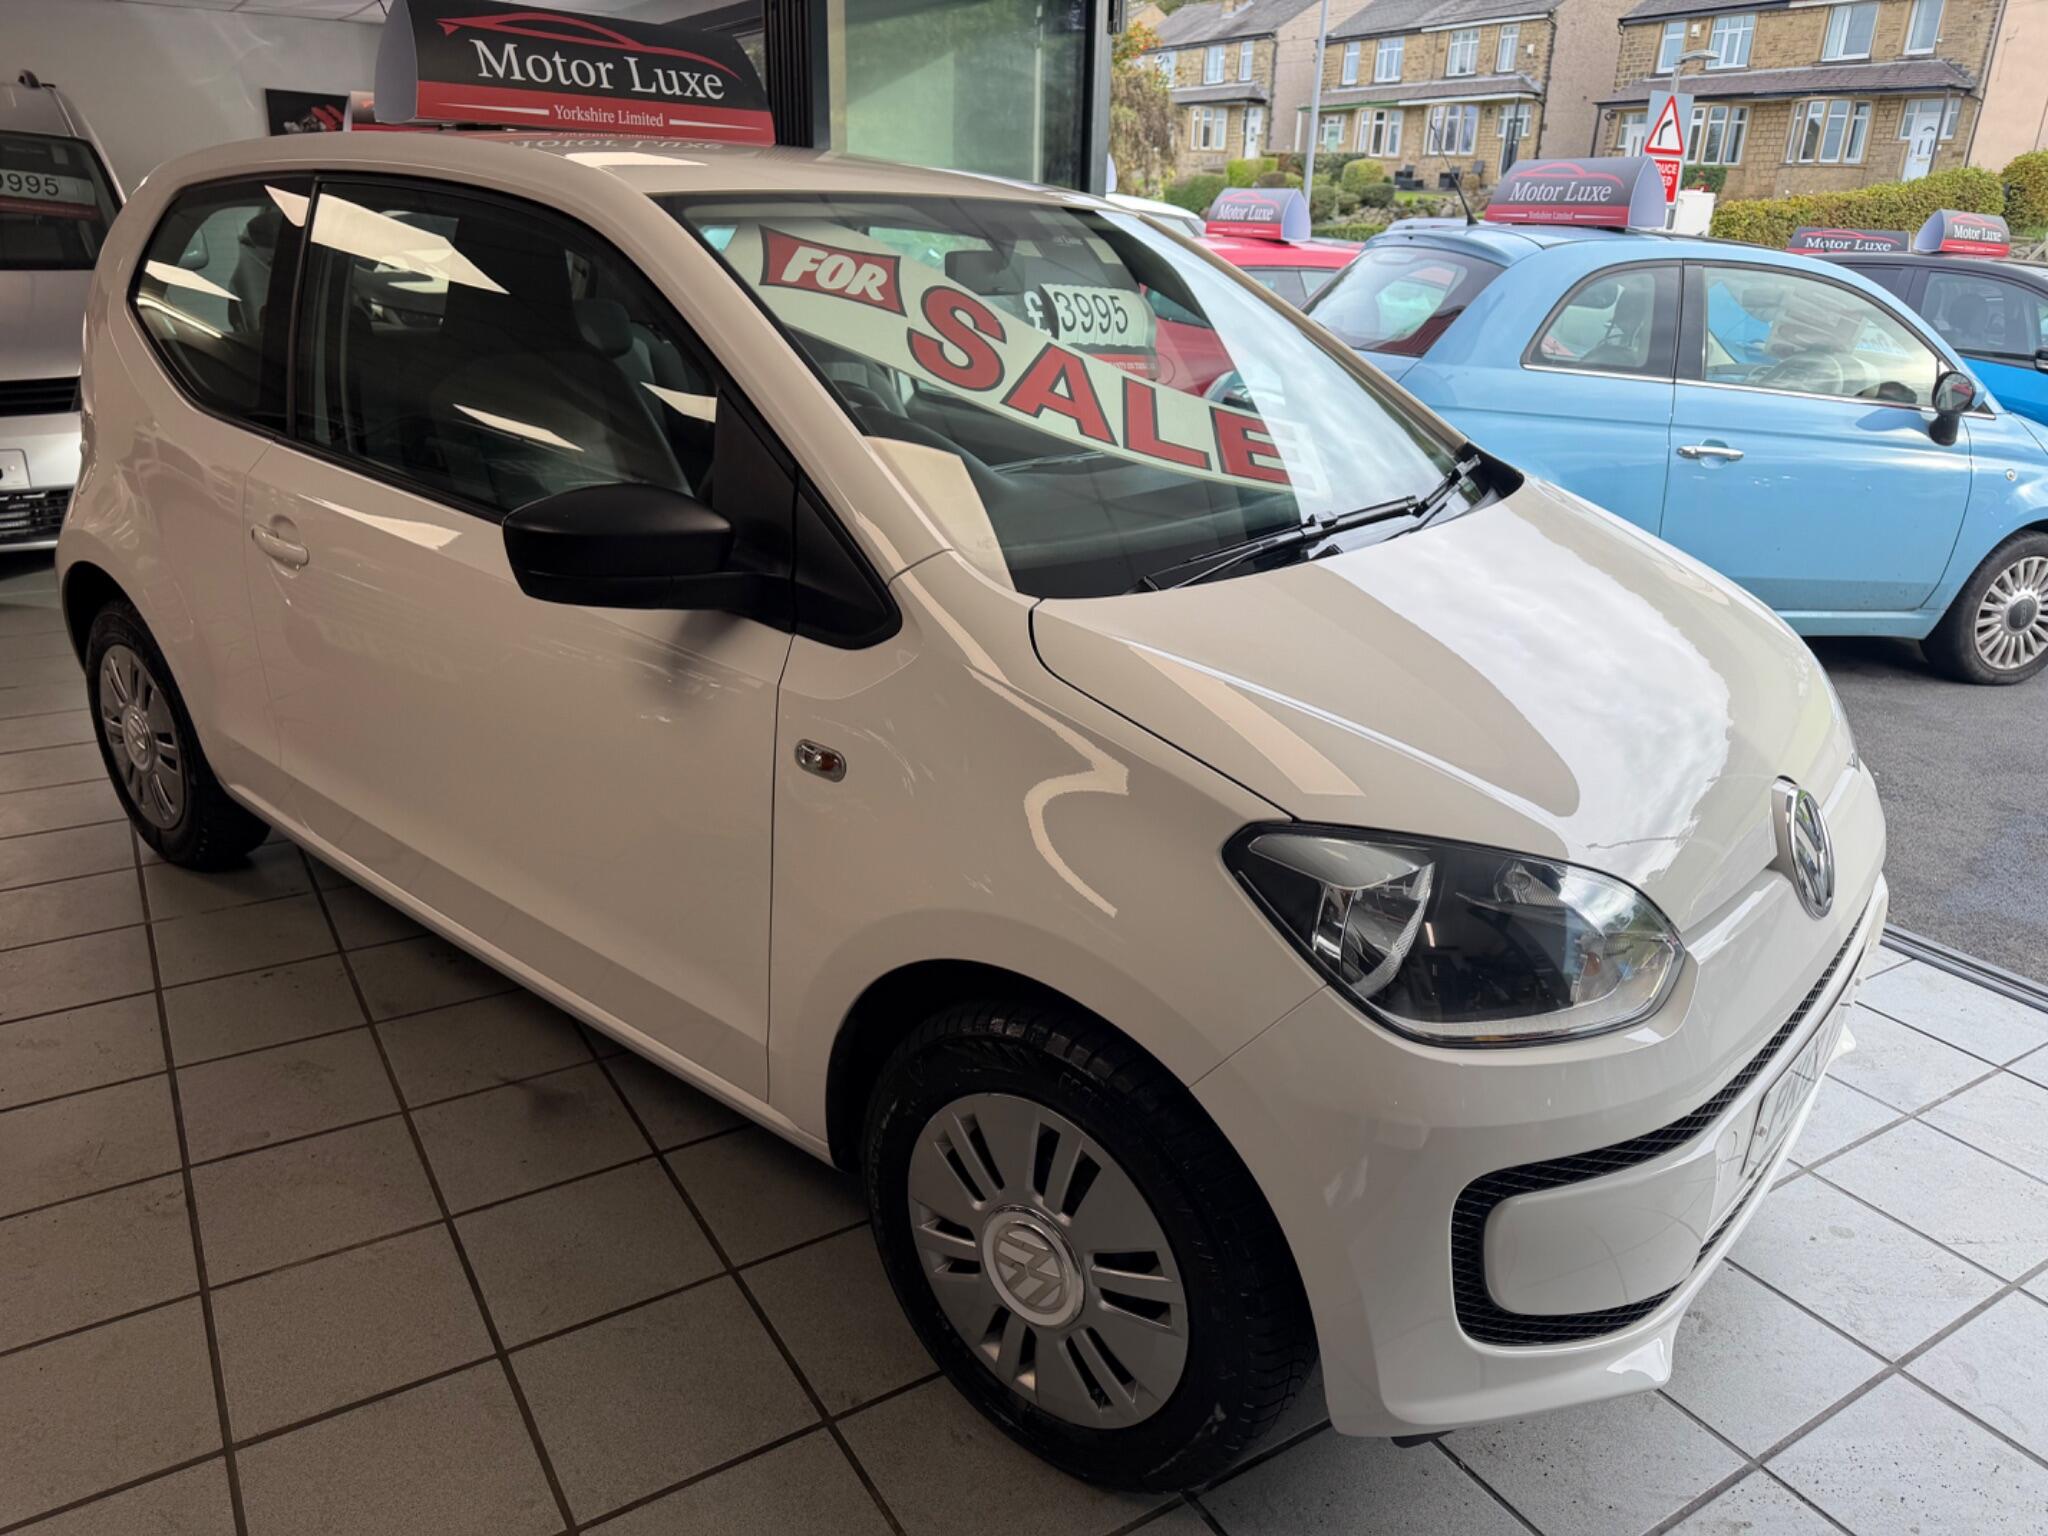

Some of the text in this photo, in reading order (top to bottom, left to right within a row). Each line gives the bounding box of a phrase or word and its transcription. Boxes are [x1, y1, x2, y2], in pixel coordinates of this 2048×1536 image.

[469, 38, 725, 100] Motor Luxe
[554, 105, 664, 127] Yorkshire Limited
[0, 172, 59, 196] 995
[1508, 181, 1612, 201] Motor Luxe
[1217, 203, 1274, 221] Motor Luxe
[1953, 224, 2002, 242] Motor Luxe
[1805, 237, 1892, 252] Motor Luxe
[781, 245, 888, 301] FOR
[907, 285, 1316, 491] SALE
